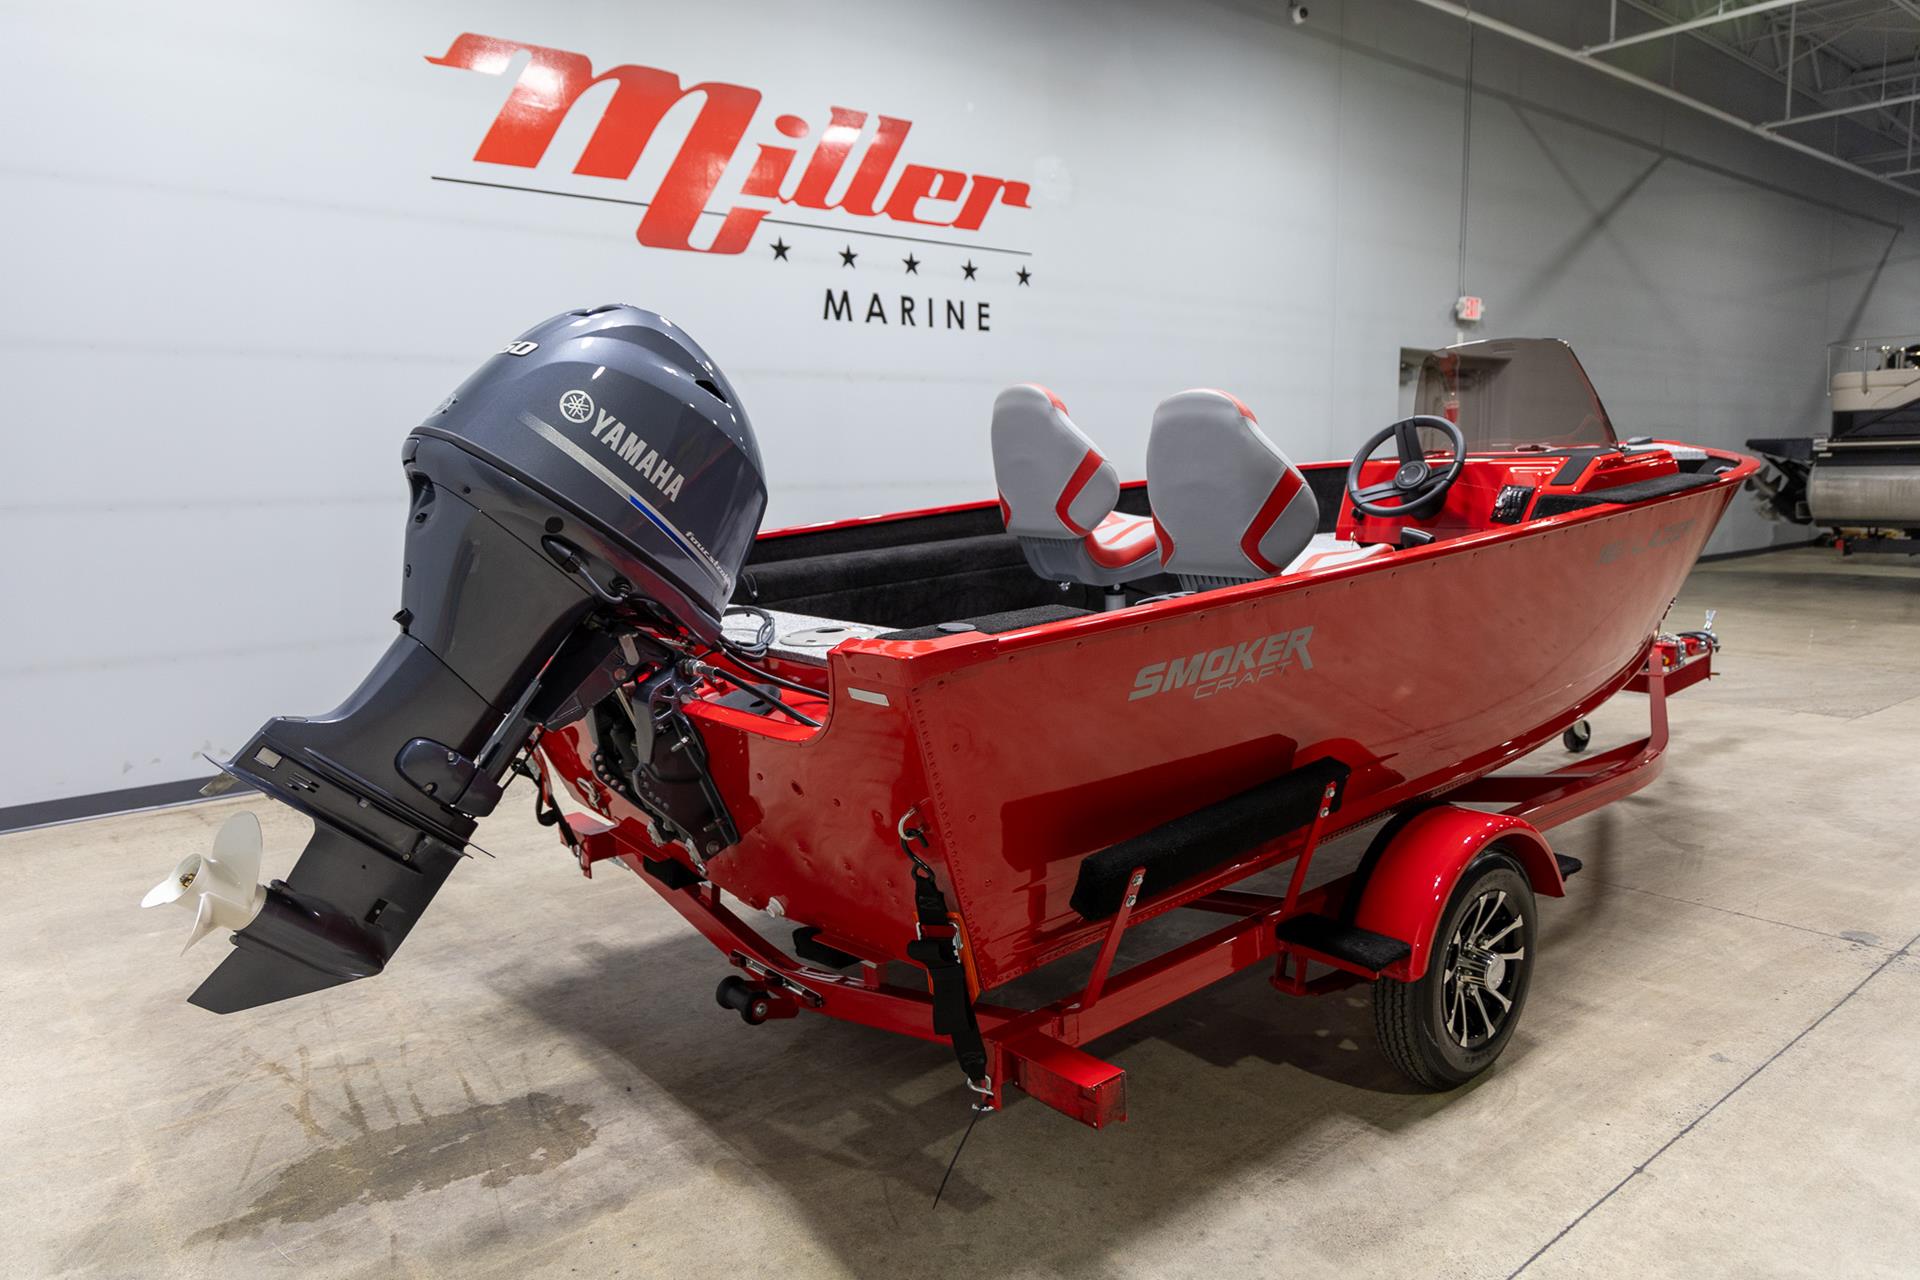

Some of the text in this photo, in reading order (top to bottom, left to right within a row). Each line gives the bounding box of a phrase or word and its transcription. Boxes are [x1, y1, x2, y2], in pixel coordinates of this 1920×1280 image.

[424, 32, 1031, 254] Miller
[823, 288, 990, 331] MARINE
[591, 408, 686, 502] YAMAHA
[1128, 625, 1314, 701] SMOKER
[1193, 660, 1294, 699] CRAFT
